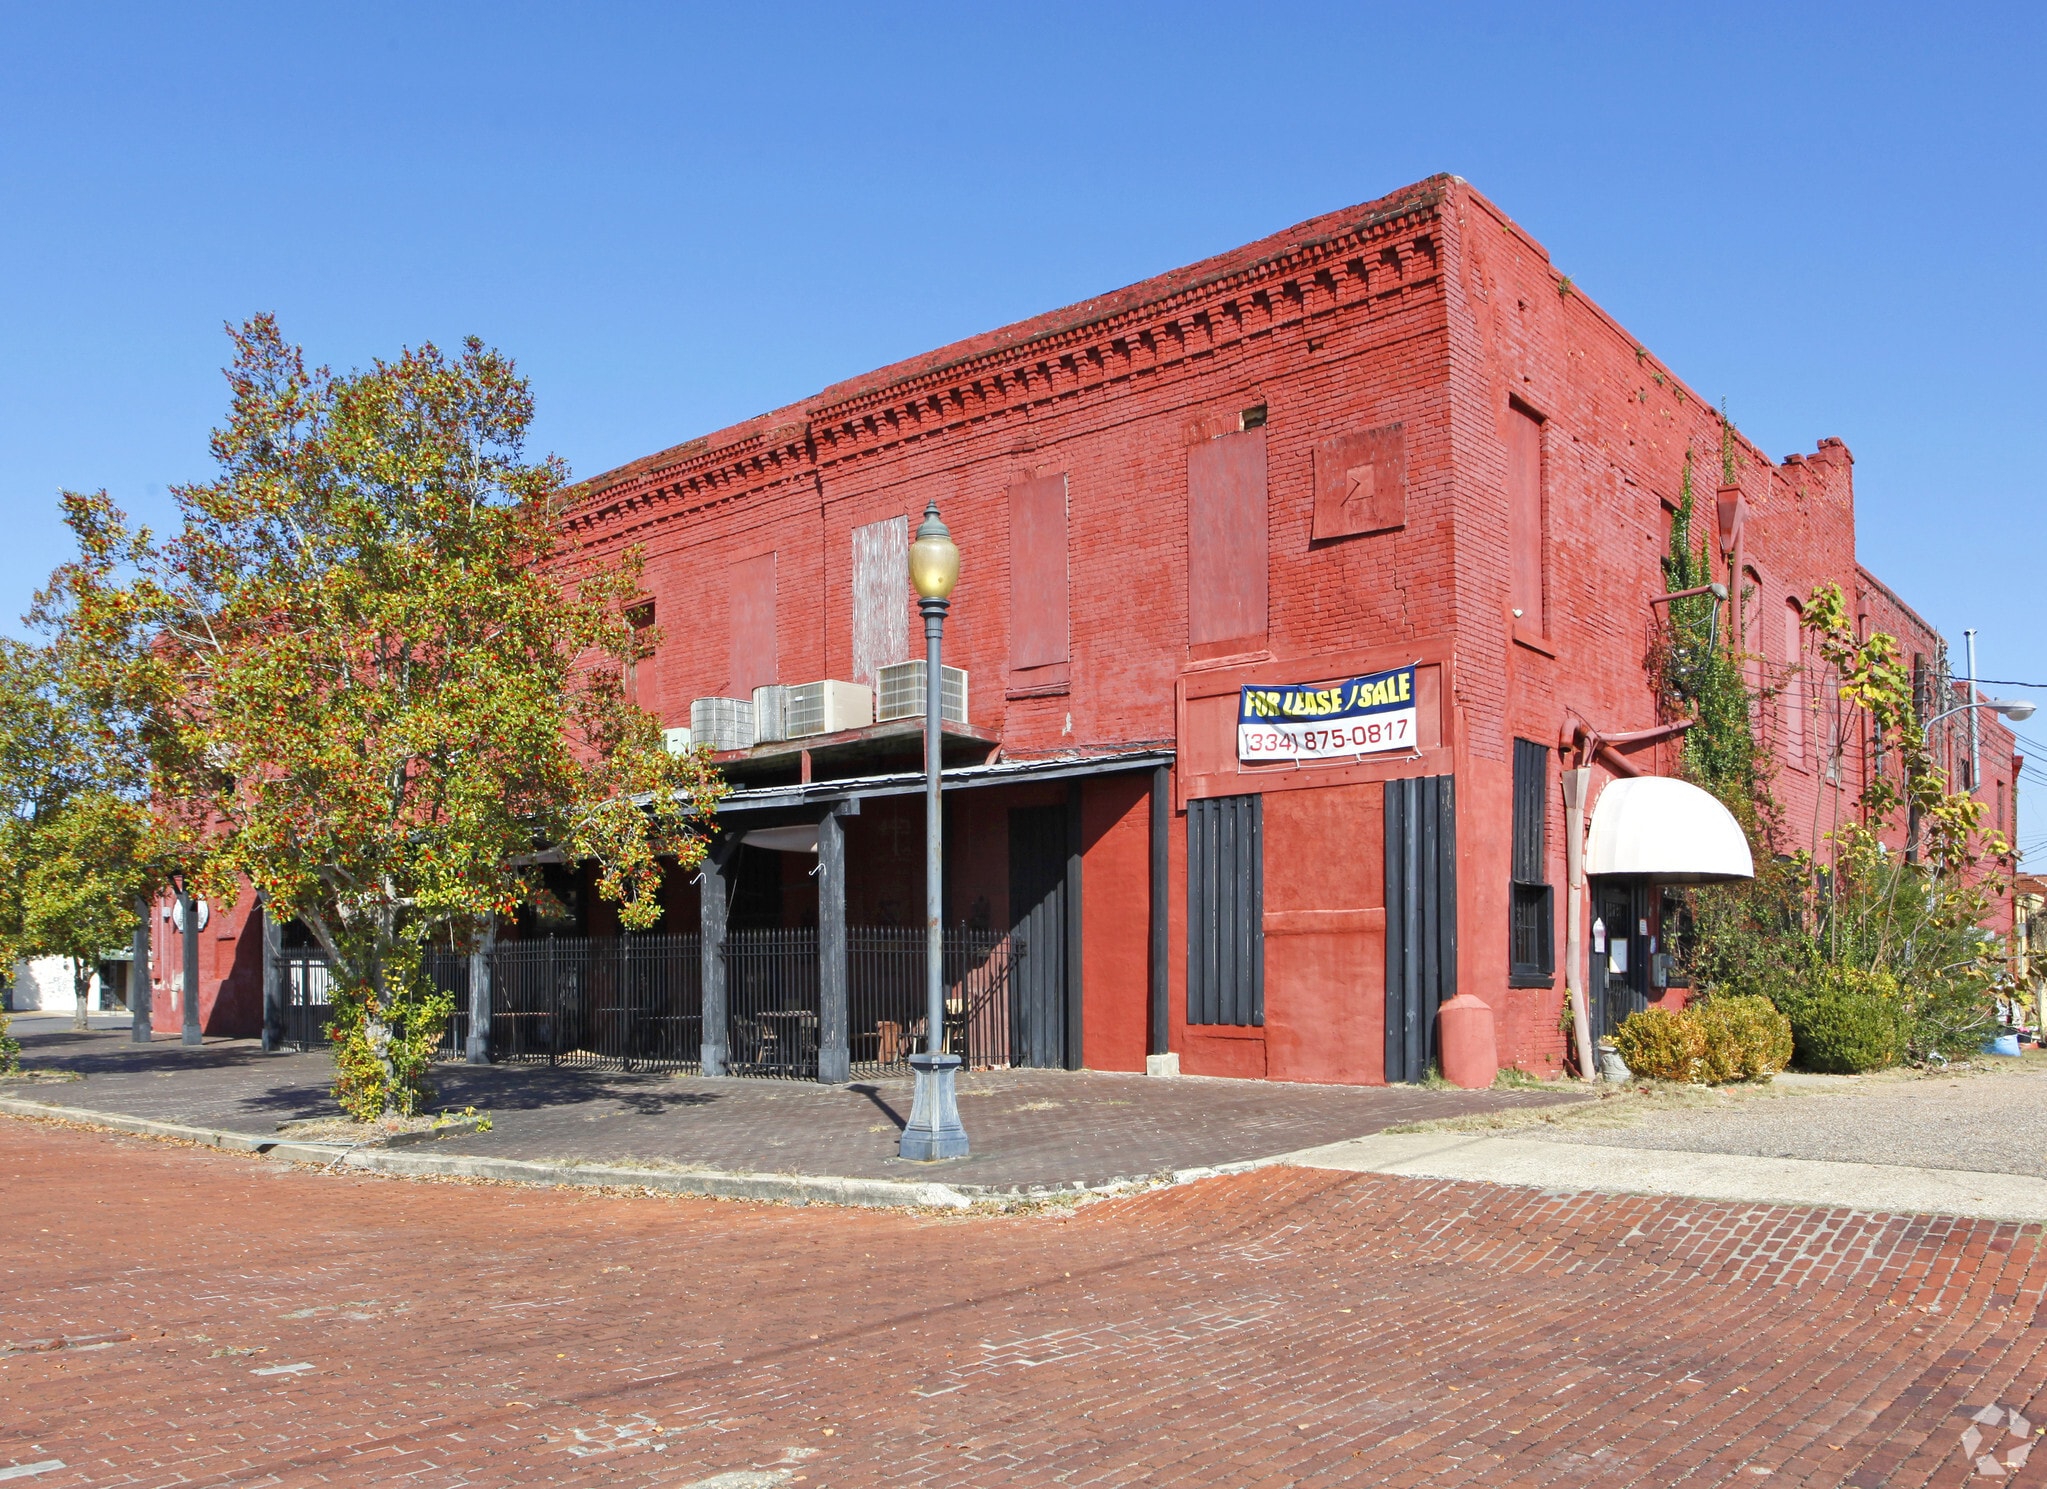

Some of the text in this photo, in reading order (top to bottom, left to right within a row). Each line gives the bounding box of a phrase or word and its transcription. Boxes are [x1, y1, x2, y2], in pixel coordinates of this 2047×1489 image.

[1244, 691, 1281, 717] FOR
[1282, 687, 1343, 716] LEASE
[1245, 719, 1408, 755] (334) 875-0817
